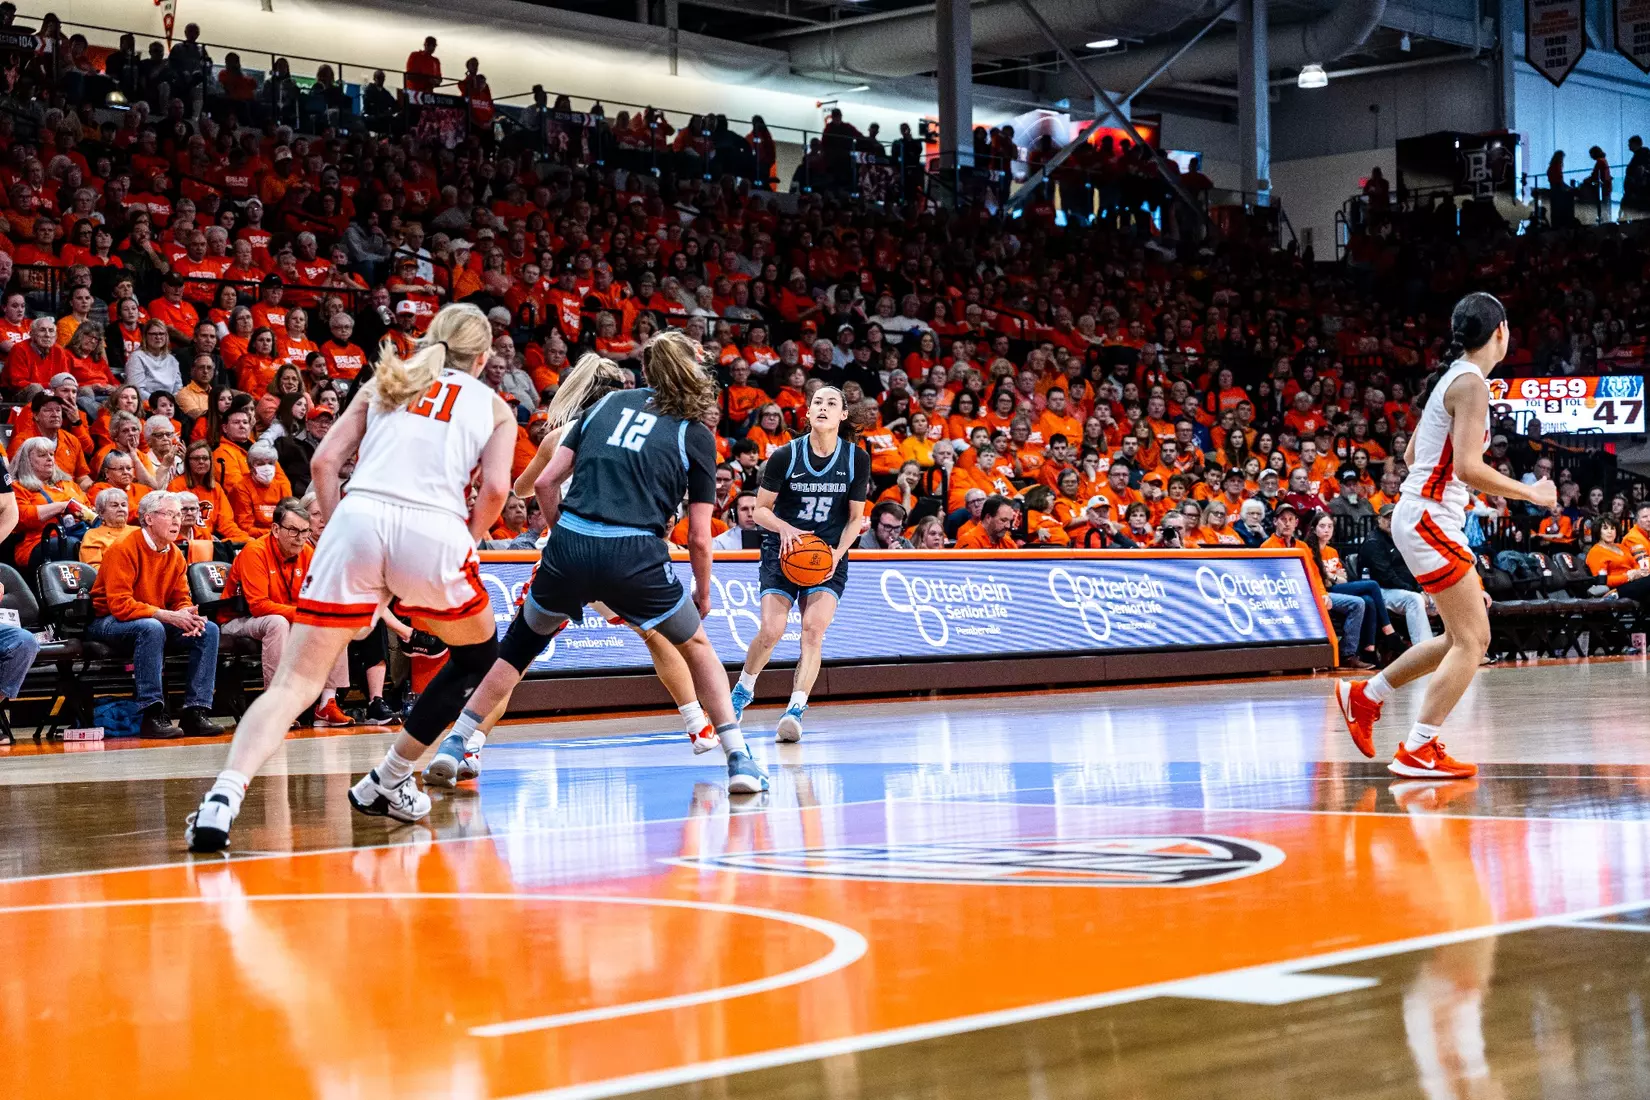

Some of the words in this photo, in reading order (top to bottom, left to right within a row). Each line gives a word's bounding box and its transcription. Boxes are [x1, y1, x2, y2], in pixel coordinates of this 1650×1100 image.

[19, 35, 33, 48] 104
[6, 331, 31, 343] BEA
[1521, 378, 1587, 398] 6:59
[406, 380, 462, 422] 21
[1547, 400, 1560, 412] 3
[1593, 400, 1643, 425] 47
[606, 407, 658, 452] 12
[790, 482, 847, 493] COLUMBIA
[797, 496, 833, 522] 35
[912, 575, 1013, 603] Otterbein
[1076, 573, 1166, 600] Otterbein
[1220, 571, 1302, 597] Otterbein
[565, 637, 624, 648] Pemberville
